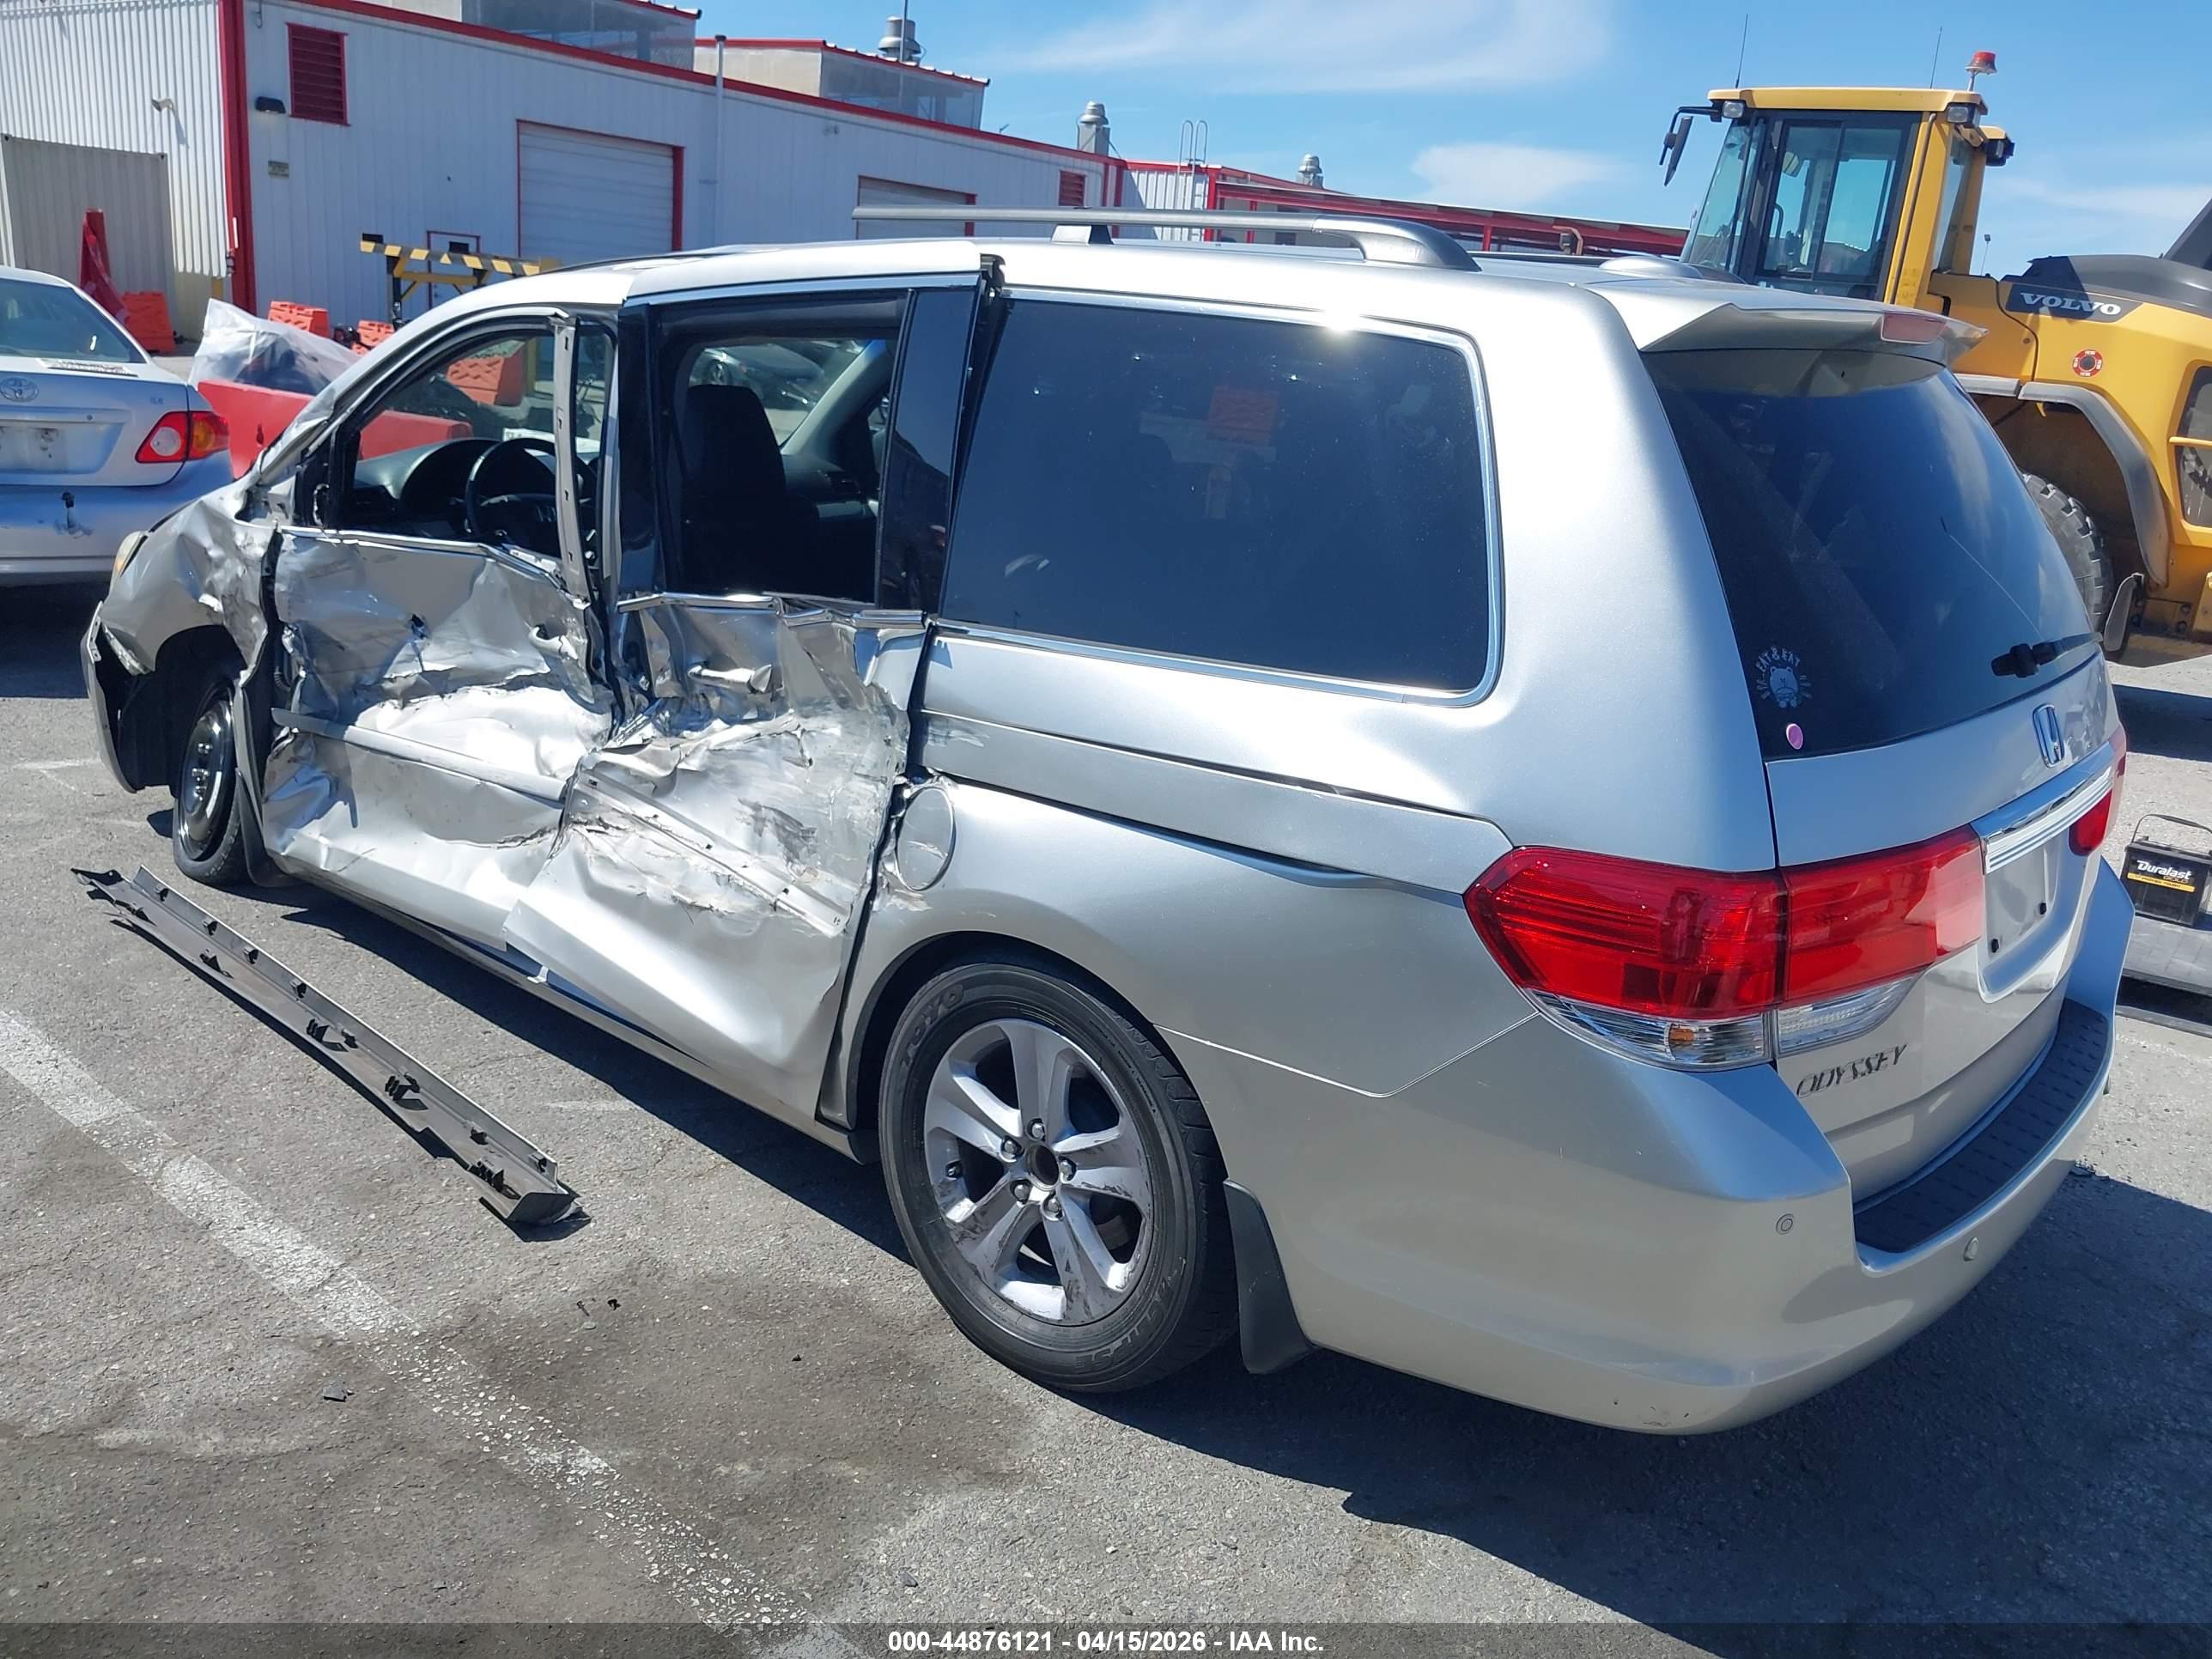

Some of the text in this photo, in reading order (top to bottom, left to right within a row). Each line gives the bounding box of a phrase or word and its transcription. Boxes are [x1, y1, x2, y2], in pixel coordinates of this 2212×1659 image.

[2020, 292, 2121, 315] VOLVO
[2136, 860, 2192, 880] Duralast
[1796, 1044, 1907, 1097] ODYSSEY
